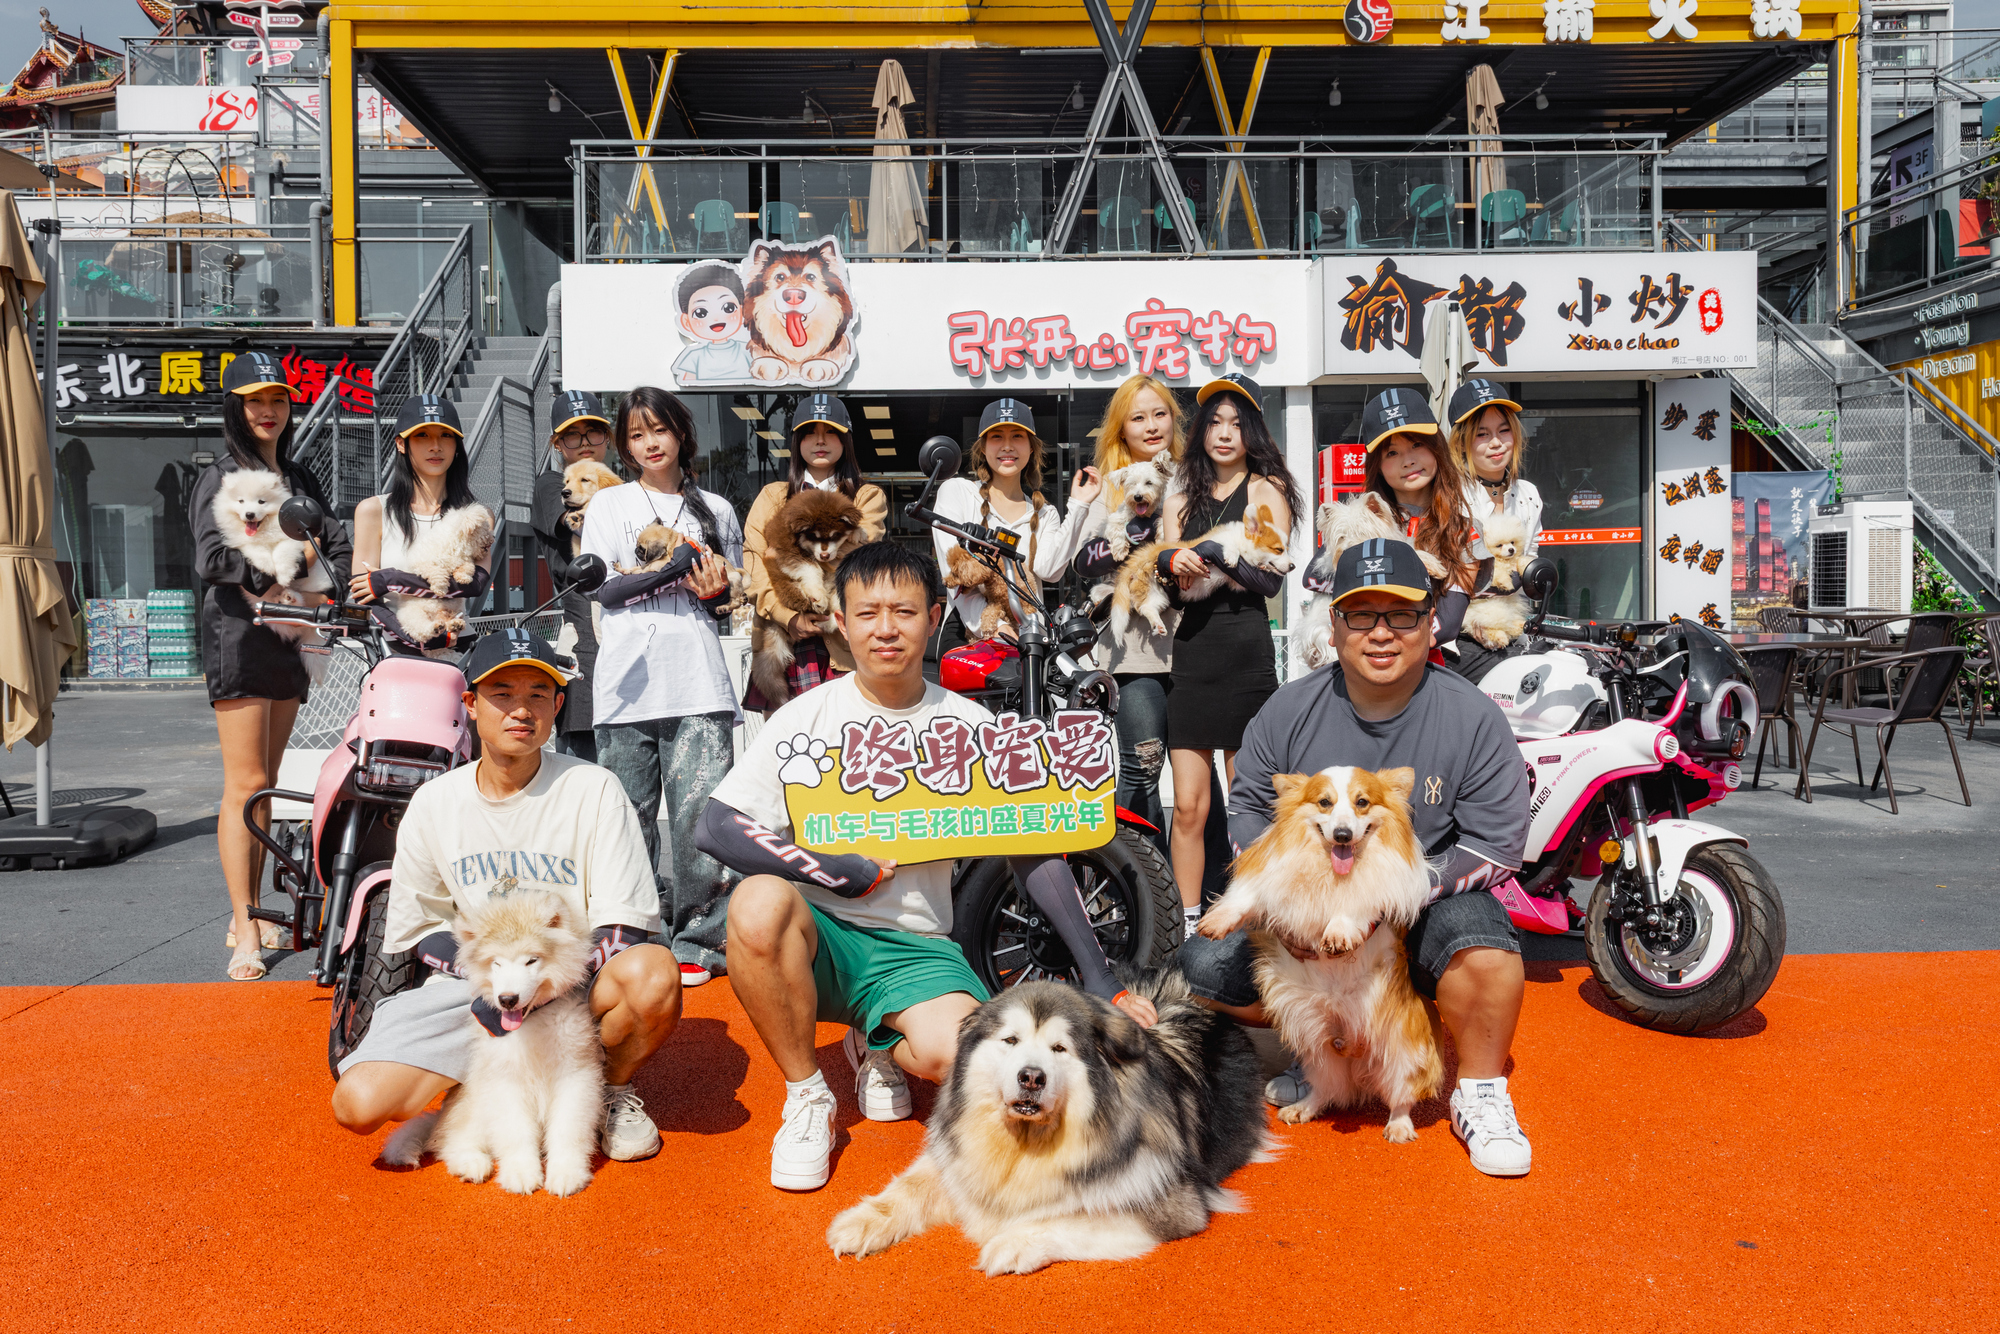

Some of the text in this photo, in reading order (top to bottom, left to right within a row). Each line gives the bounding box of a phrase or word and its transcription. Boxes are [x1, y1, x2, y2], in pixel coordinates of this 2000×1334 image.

[1915, 149, 1928, 167] 3F
[1558, 272, 1694, 329] 小炒
[1919, 293, 1978, 322] Fashion
[947, 298, 1276, 379] 张开心宠物
[1566, 332, 1680, 351] Xiaochao
[1921, 322, 1969, 349] Young
[1671, 355, 1711, 365] 两江一号店
[1922, 353, 1976, 380] Dream
[1661, 402, 1720, 441] 炒菜
[1790, 486, 1803, 537] 就是筷子
[950, 655, 984, 668] CYCLONE
[841, 710, 1114, 800] 终身宠爱
[1556, 766, 1570, 781] PINK
[1569, 748, 1592, 767] POWER
[1537, 786, 1552, 805] 150
[804, 802, 1105, 845] 机车与毛孩的盛夏光年
[733, 814, 850, 888] PUNK
